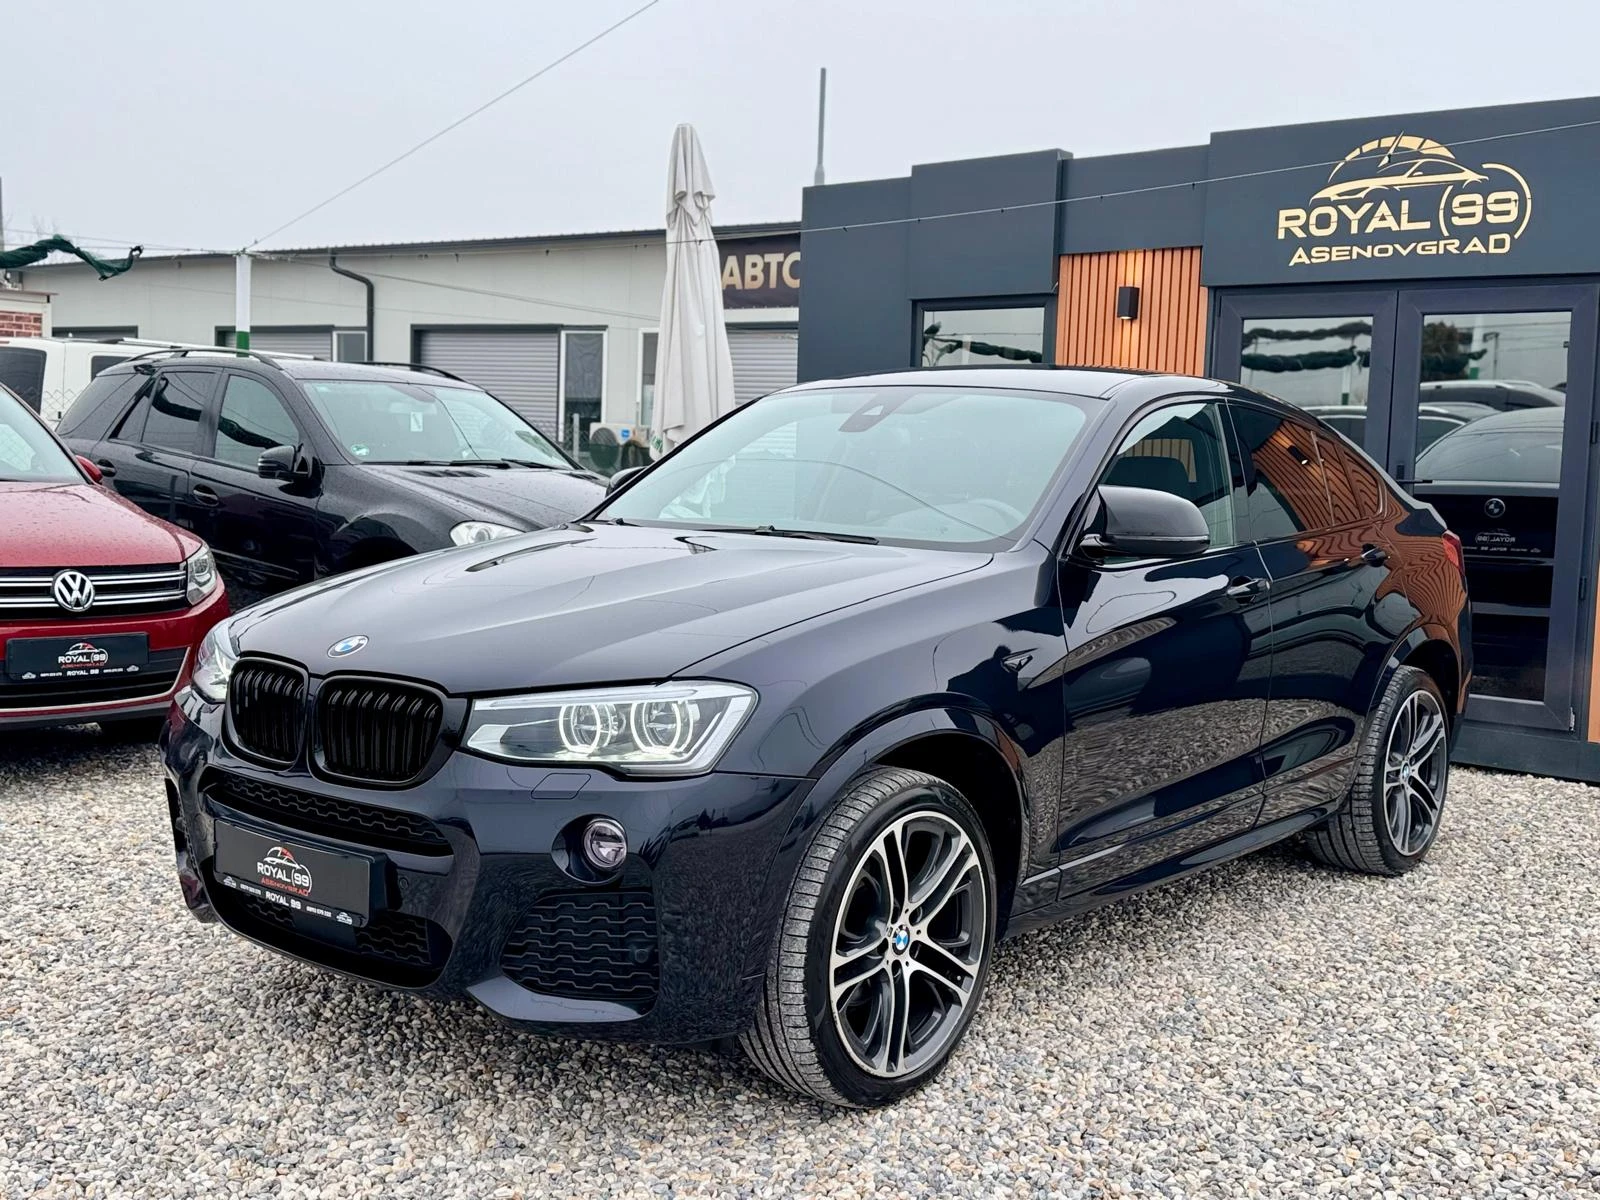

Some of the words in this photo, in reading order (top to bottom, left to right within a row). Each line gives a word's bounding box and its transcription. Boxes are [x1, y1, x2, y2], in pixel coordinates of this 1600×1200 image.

[1277, 200, 1431, 239] ROYAL
[1288, 233, 1511, 267] ASENOVGRAD
[58, 654, 90, 663] ROYAL
[257, 861, 291, 882] ROYAL
[265, 890, 289, 906] ROYAL
